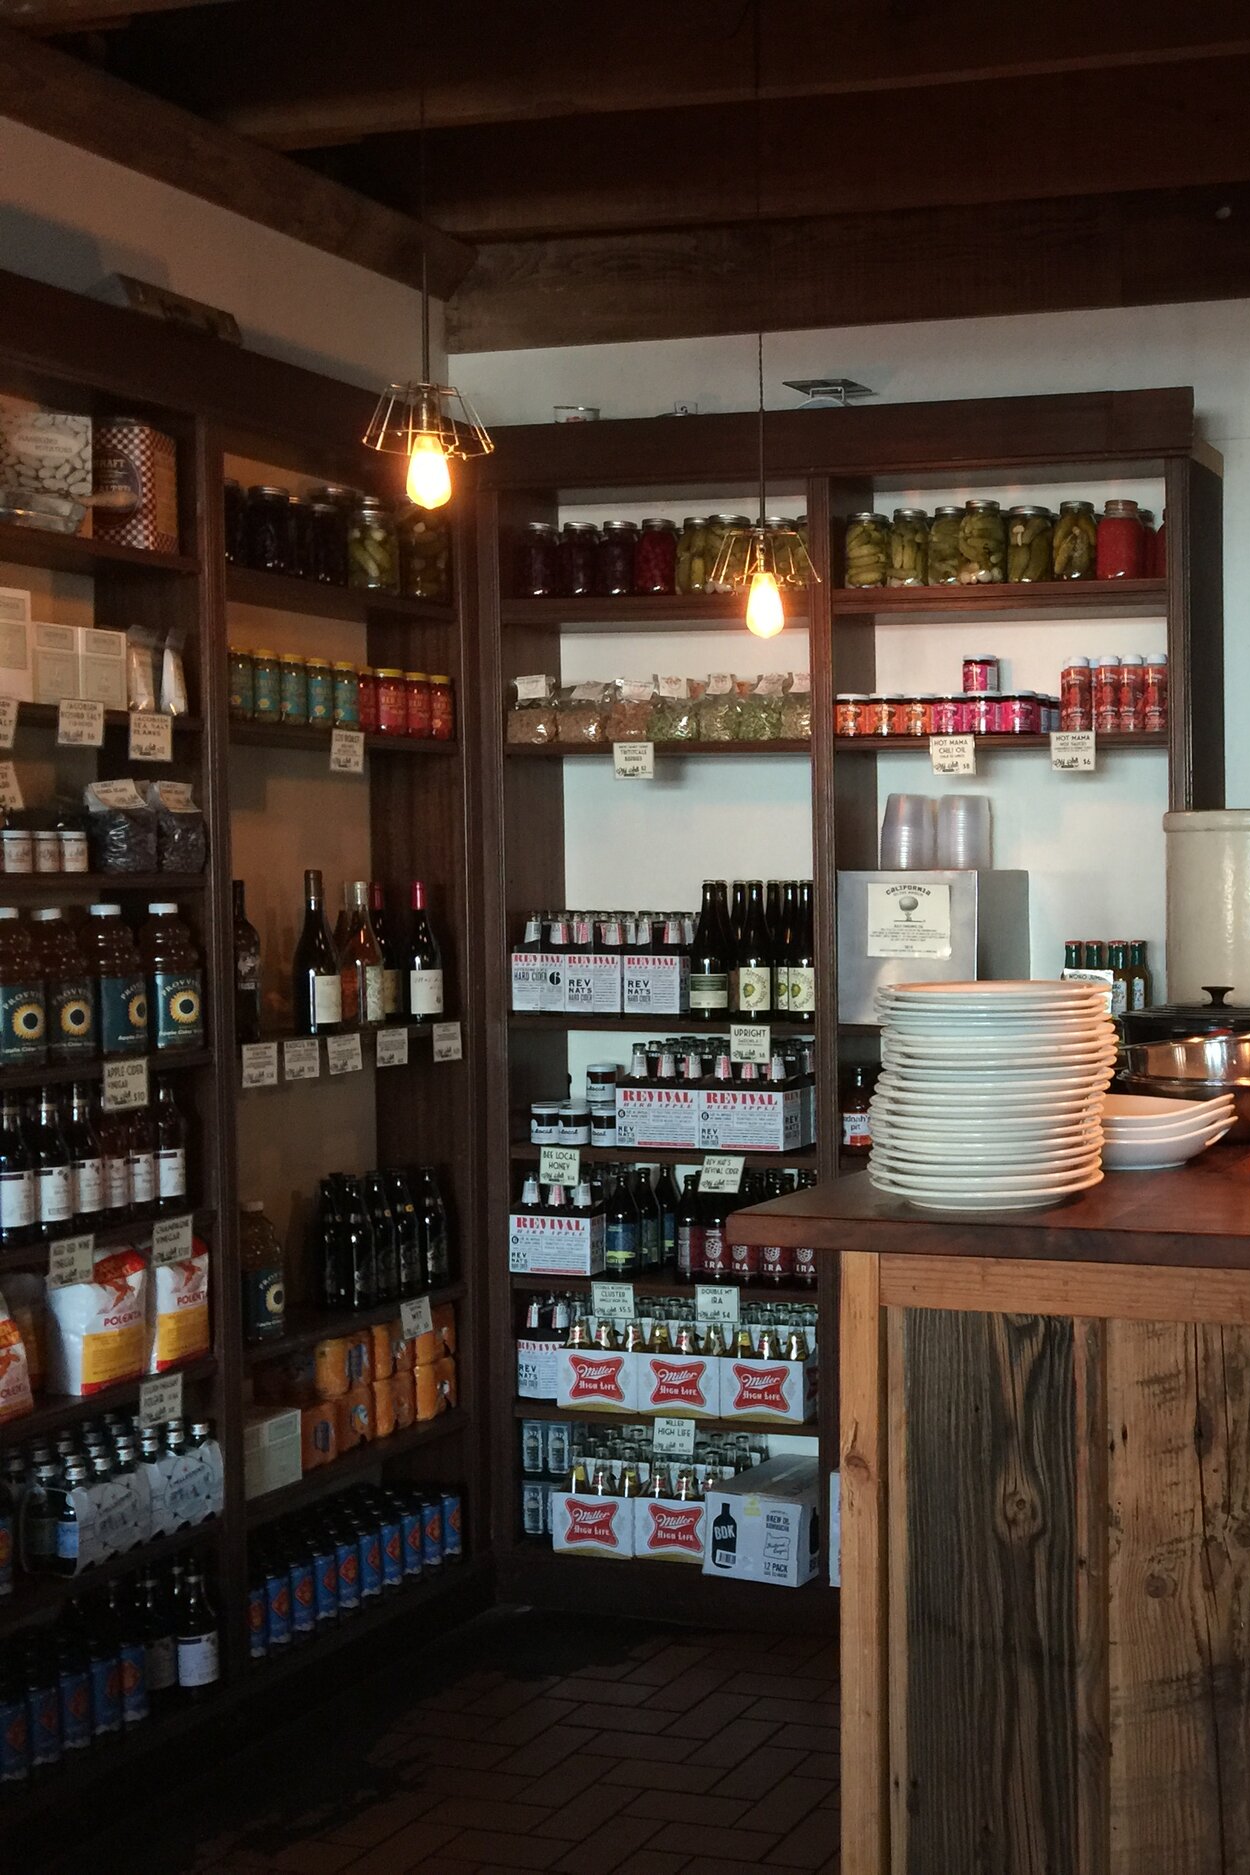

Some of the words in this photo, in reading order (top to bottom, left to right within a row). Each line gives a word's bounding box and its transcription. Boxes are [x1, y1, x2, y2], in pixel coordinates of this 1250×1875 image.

[885, 885, 931, 896] CALIFORNIA
[514, 954, 563, 963] REVIVAL
[568, 956, 618, 965] REVIVAL
[627, 957, 677, 966] REVIVAL
[549, 971, 561, 985] 6
[568, 979, 591, 987] REV
[627, 980, 649, 988] REV
[733, 1029, 766, 1037] UPRIGHT
[623, 1090, 694, 1103] REVIVAL
[706, 1093, 777, 1105] REVIVAL
[543, 1151, 554, 1159] BEE
[556, 1152, 576, 1161] LOCAL
[548, 1162, 570, 1170] HONEY
[516, 1217, 585, 1231] REVIVAL
[705, 1260, 724, 1268] IRA
[732, 1262, 748, 1270] IRA
[764, 1263, 782, 1271] IRA
[796, 1264, 815, 1272] IRA
[518, 1363, 537, 1372] REV
[576, 1364, 616, 1378] Miller
[657, 1369, 698, 1383] Miller
[578, 1381, 598, 1389] HIGH
[740, 1374, 781, 1388] Miller
[659, 1385, 679, 1394] HIGH
[742, 1390, 762, 1400] HIGH
[657, 1428, 675, 1436] HIGH
[677, 1429, 691, 1437] LIFE
[573, 1508, 610, 1522] Miller
[655, 1514, 695, 1528] Miller
[574, 1525, 592, 1534] HIGH
[713, 1525, 736, 1540] BDK
[657, 1531, 676, 1540] HIGH
[772, 1562, 788, 1573] PACK
